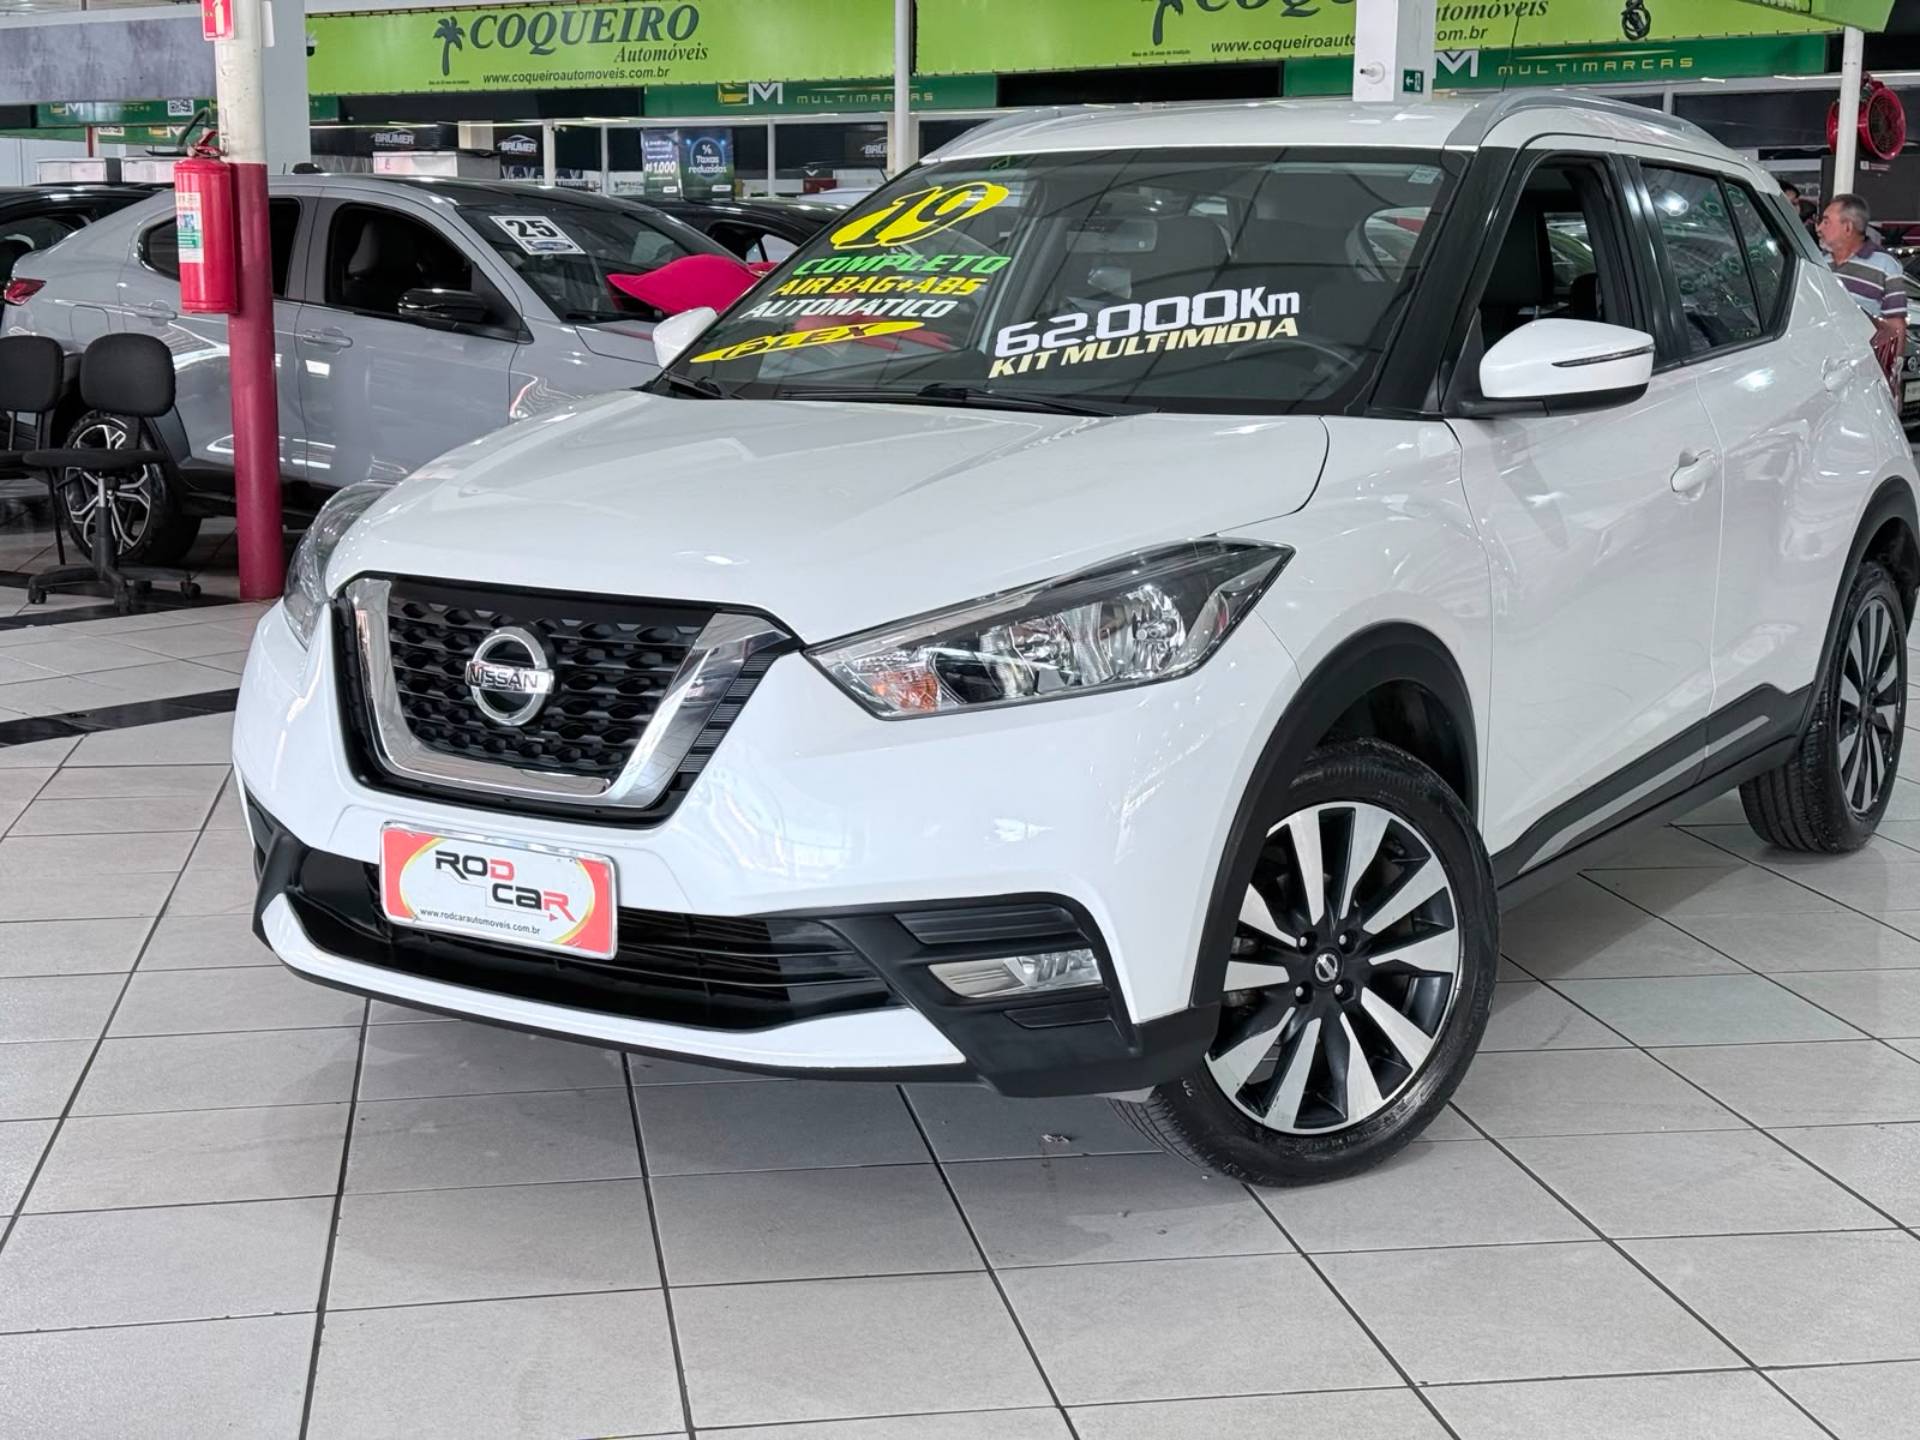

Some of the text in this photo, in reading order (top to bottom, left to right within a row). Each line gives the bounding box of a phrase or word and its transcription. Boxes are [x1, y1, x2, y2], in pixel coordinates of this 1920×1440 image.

[1436, 0, 1548, 22] tomóveis
[470, 4, 700, 55] COQUEIRO
[614, 43, 708, 63] Automóveis
[483, 66, 670, 84] www.coqueiroautomoveis.com.br
[1498, 57, 1694, 76] MULTIMARCAS
[797, 92, 934, 104] MULTIMARAS
[505, 220, 558, 237] 25
[792, 254, 1012, 276] COMPLETO
[722, 323, 876, 359] FLEX
[988, 350, 1058, 379] KIT
[470, 662, 538, 690] NISSAN
[435, 850, 515, 881] ROD
[420, 907, 541, 935] www.rodcarautomoveis.com.br
